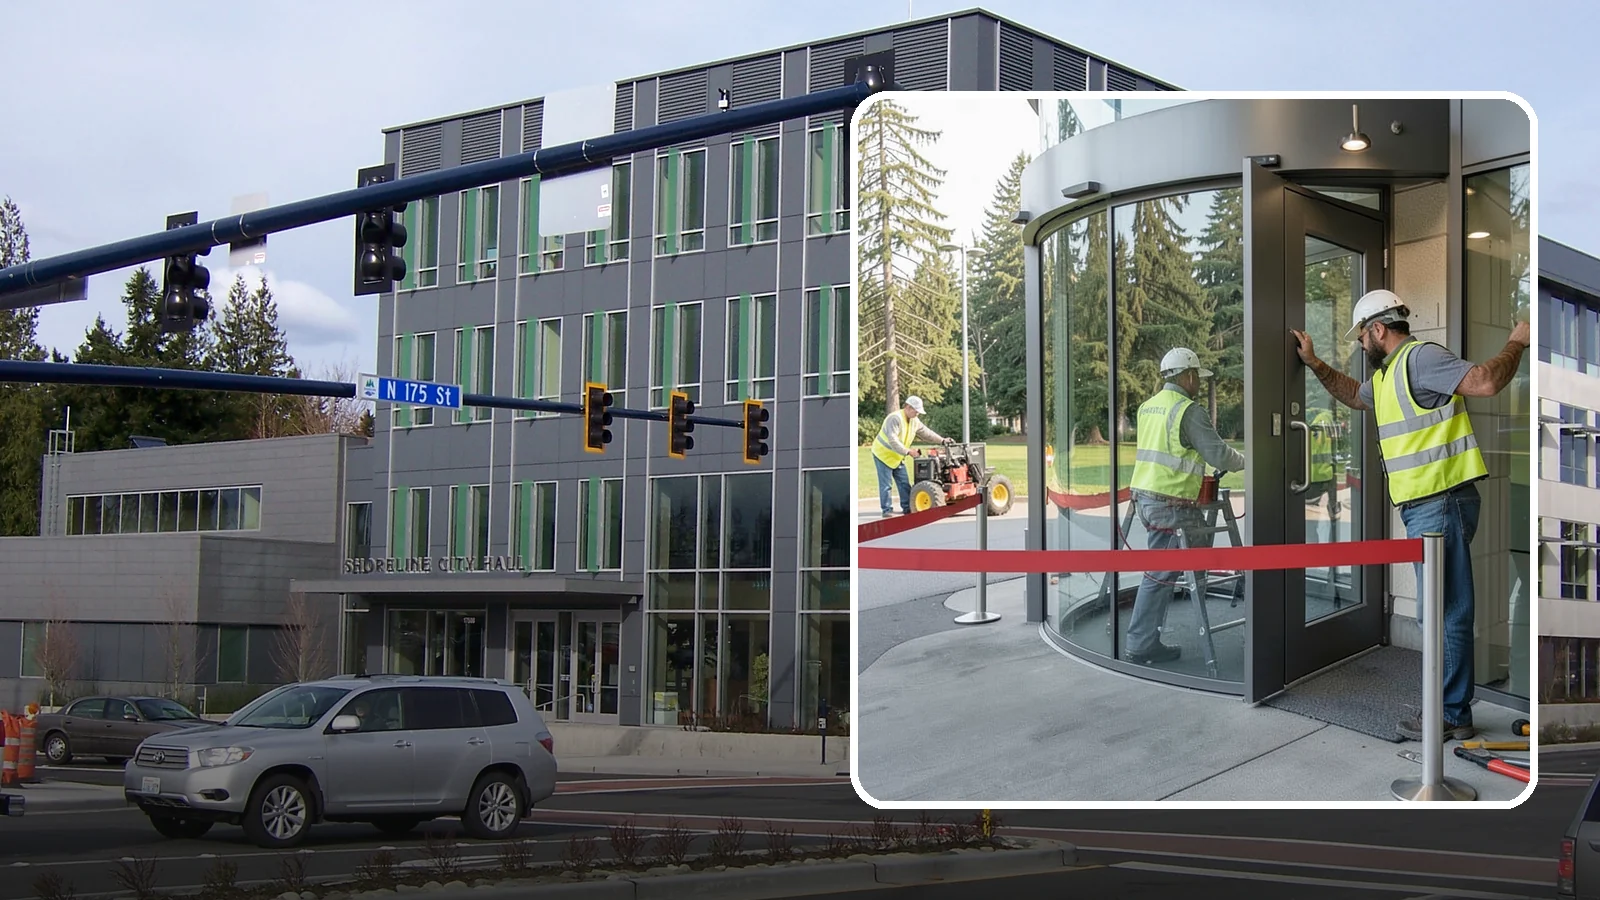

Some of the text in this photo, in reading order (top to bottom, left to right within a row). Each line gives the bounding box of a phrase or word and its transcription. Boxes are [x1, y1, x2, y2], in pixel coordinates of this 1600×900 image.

[387, 380, 451, 406] N 175 St
[344, 555, 526, 574] SHORELINE CITY HALL
